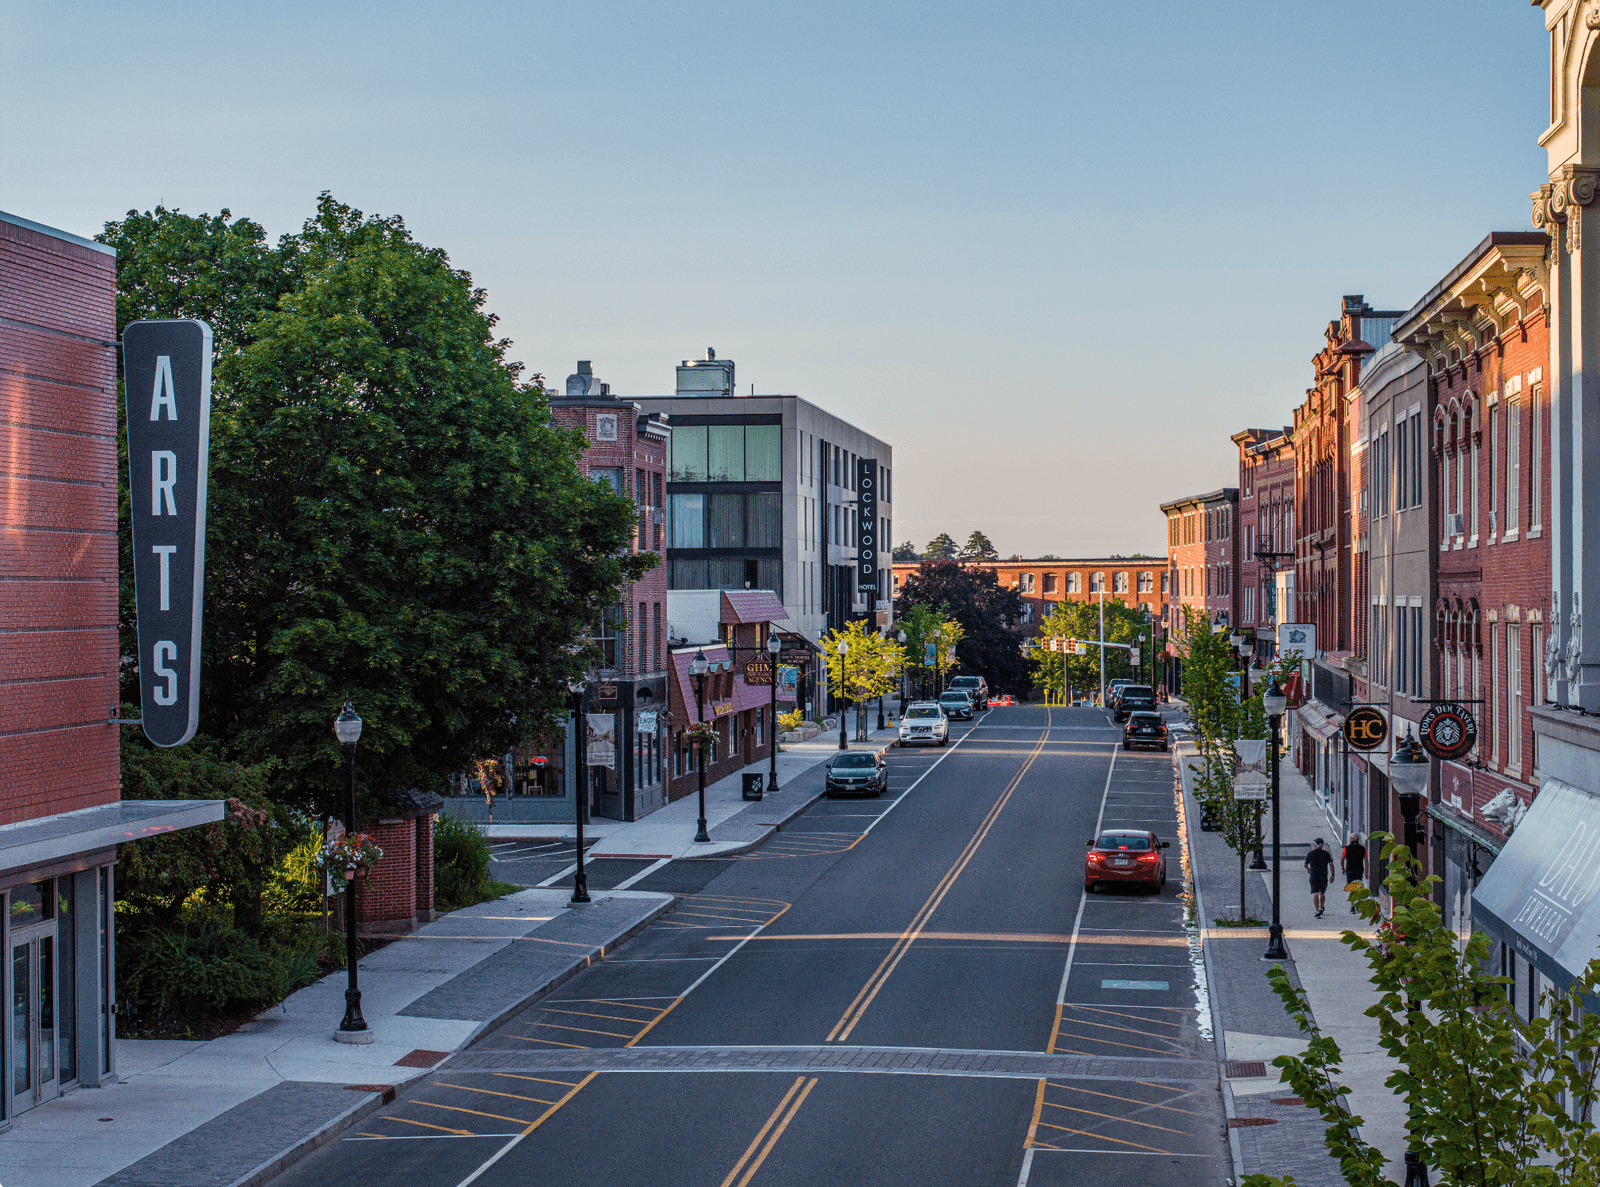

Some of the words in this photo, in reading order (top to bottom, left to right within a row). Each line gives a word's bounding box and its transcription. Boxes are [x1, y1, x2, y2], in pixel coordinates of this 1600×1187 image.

[150, 355, 178, 706] ARTS
[862, 464, 873, 574] LOCKWOOD
[1349, 719, 1383, 738] HC
[1420, 712, 1436, 735] LION'S
[1435, 704, 1453, 713] DEN
[1456, 706, 1475, 735] TAVERN
[1513, 895, 1567, 943] JEWELERS
